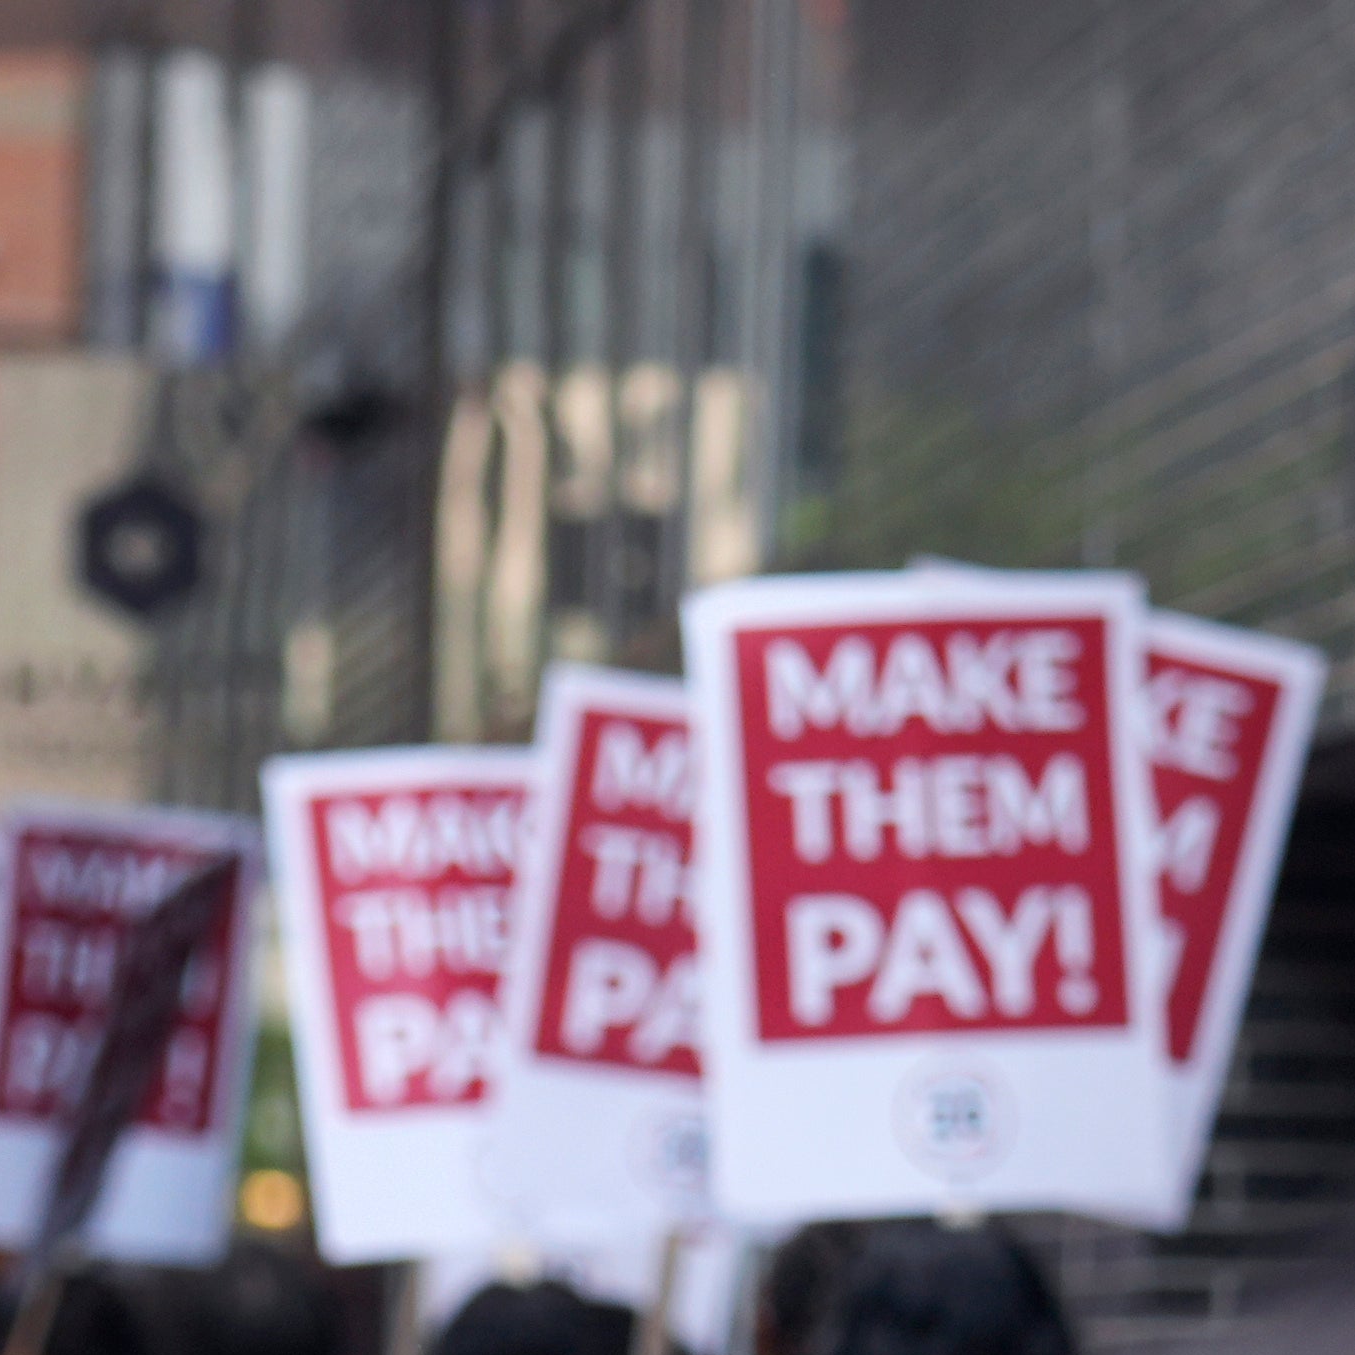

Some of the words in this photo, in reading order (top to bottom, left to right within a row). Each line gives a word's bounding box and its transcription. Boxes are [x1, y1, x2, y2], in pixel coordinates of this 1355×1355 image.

[763, 628, 1087, 741] MAKE
[324, 797, 519, 886] MAK
[765, 752, 1090, 864] THEM
[333, 886, 510, 982] THE
[785, 885, 1100, 1027] PAY!
[354, 990, 496, 1102] PA
[560, 936, 704, 1063] PA
